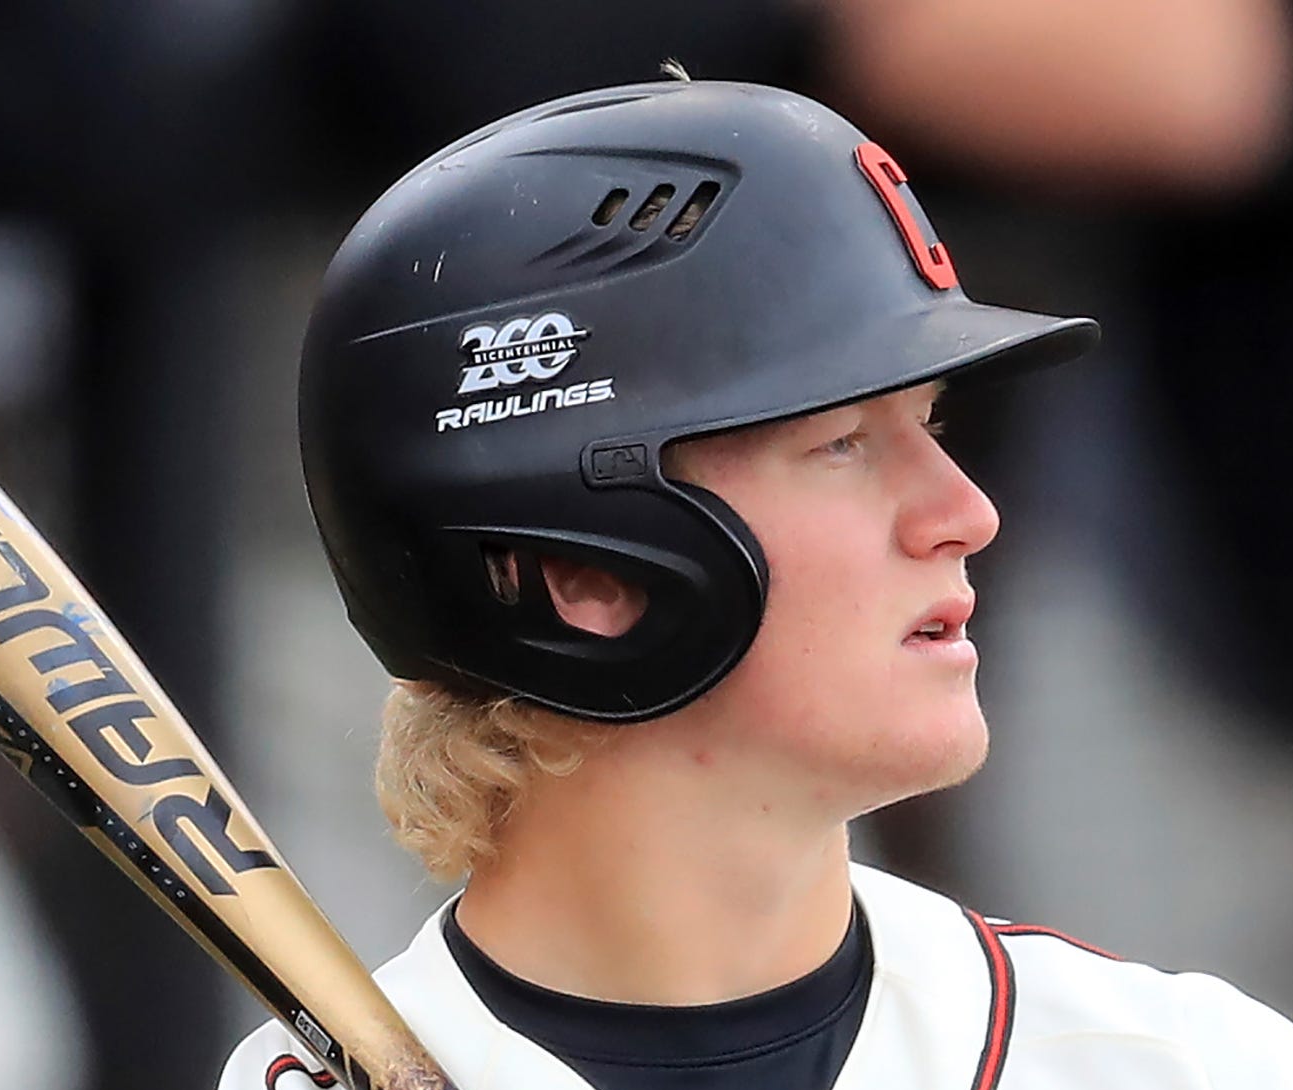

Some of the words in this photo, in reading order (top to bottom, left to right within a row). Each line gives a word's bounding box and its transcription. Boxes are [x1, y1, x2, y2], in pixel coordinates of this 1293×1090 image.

[853, 141, 959, 290] C
[474, 338, 575, 364] BICENTENNIAL
[436, 378, 615, 432] RAWLINGS
